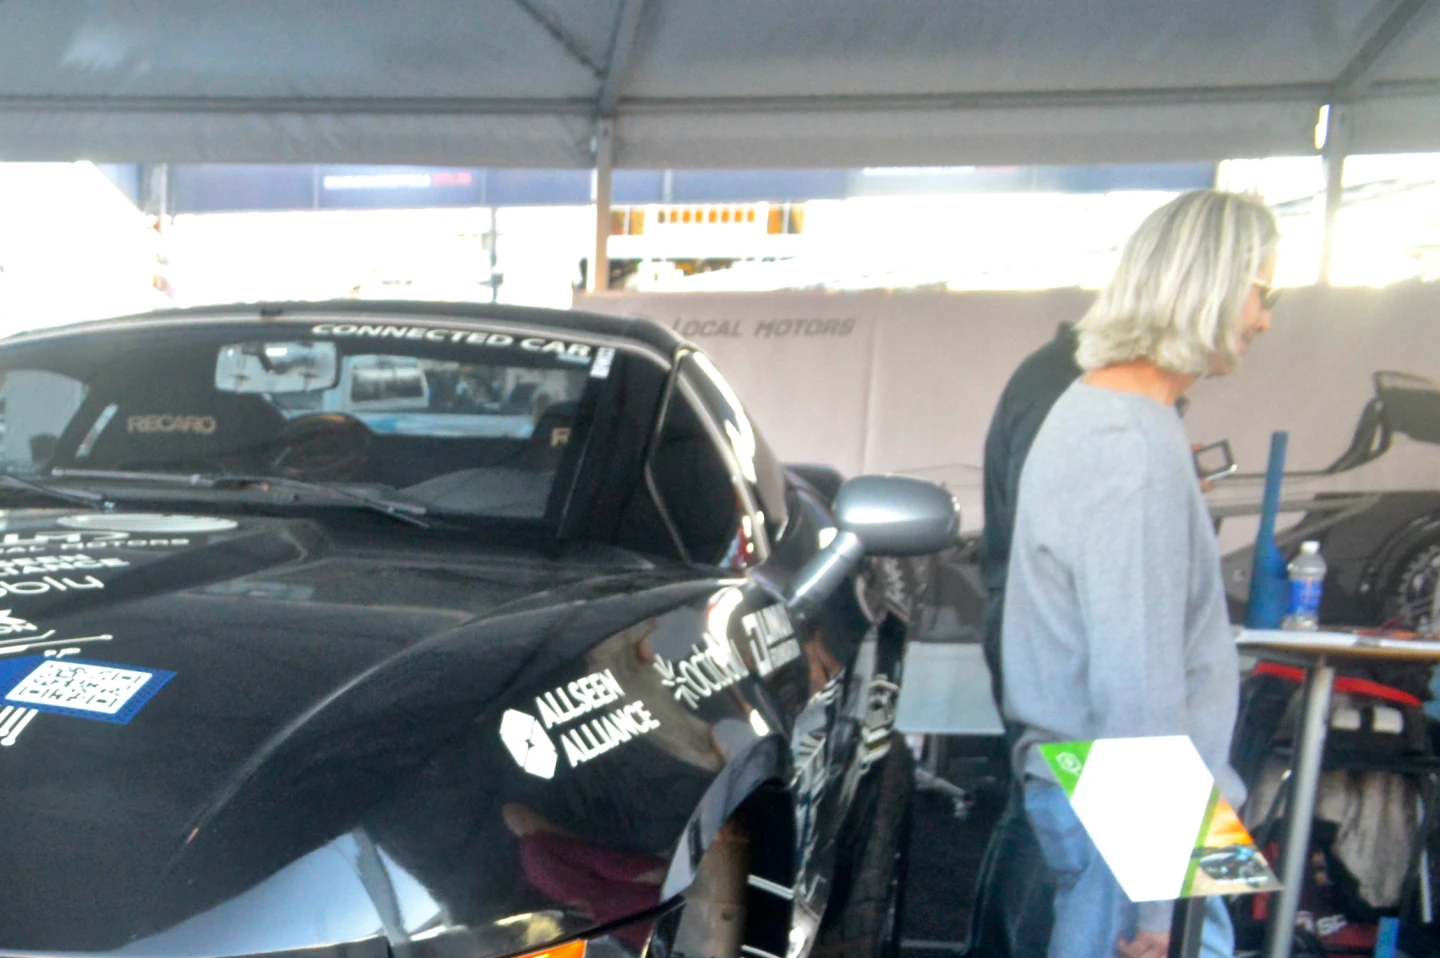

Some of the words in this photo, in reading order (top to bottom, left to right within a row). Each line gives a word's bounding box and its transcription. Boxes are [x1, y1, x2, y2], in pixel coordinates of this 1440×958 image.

[311, 323, 514, 348] CONNECTED
[520, 337, 592, 357] CAR
[672, 316, 744, 338] LOCAL
[753, 317, 857, 339] MOTORS
[126, 414, 217, 434] RECARO
[61, 537, 190, 550] MOTORS
[534, 668, 626, 730] ALLSEEN
[560, 699, 661, 768] ALLIANCE
